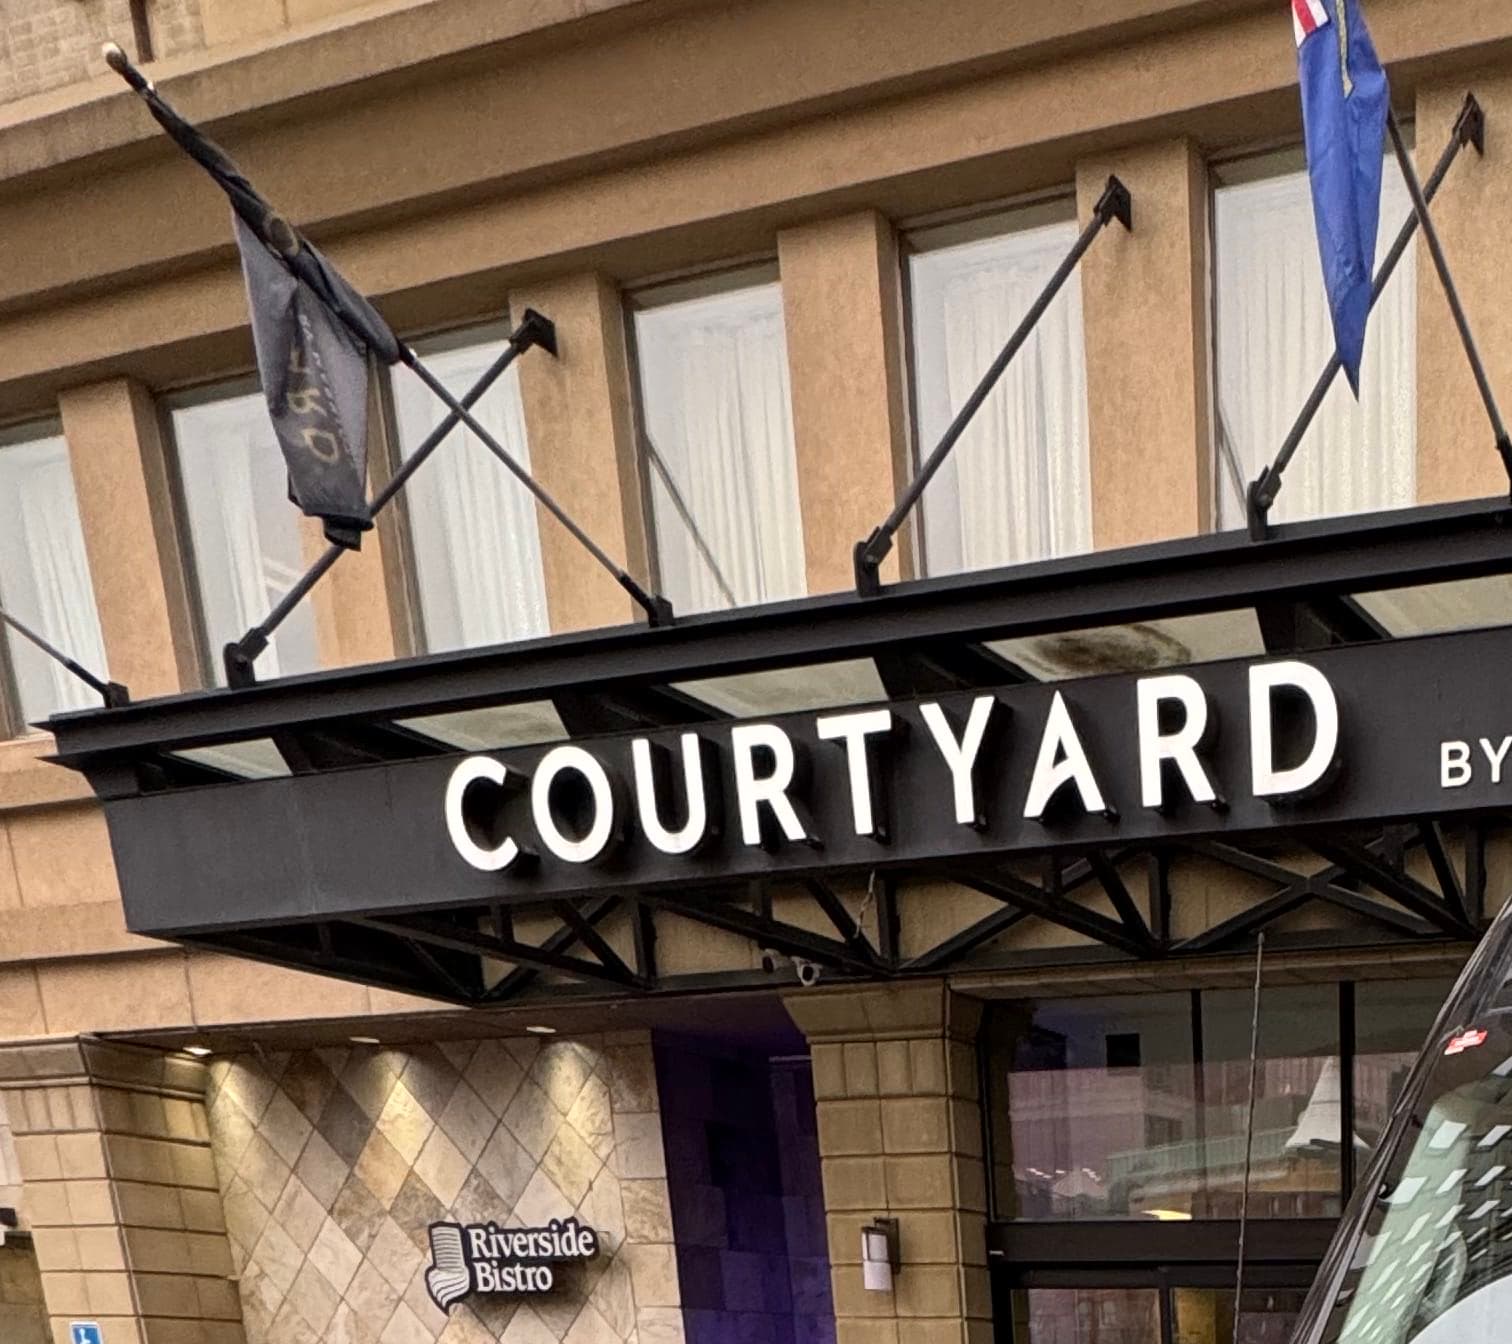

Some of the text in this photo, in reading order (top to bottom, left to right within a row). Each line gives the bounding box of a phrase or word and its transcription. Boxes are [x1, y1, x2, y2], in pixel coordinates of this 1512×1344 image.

[445, 661, 1339, 870] COURTYARD
[467, 1222, 596, 1259] Riverside
[472, 1262, 553, 1293] Bistro
